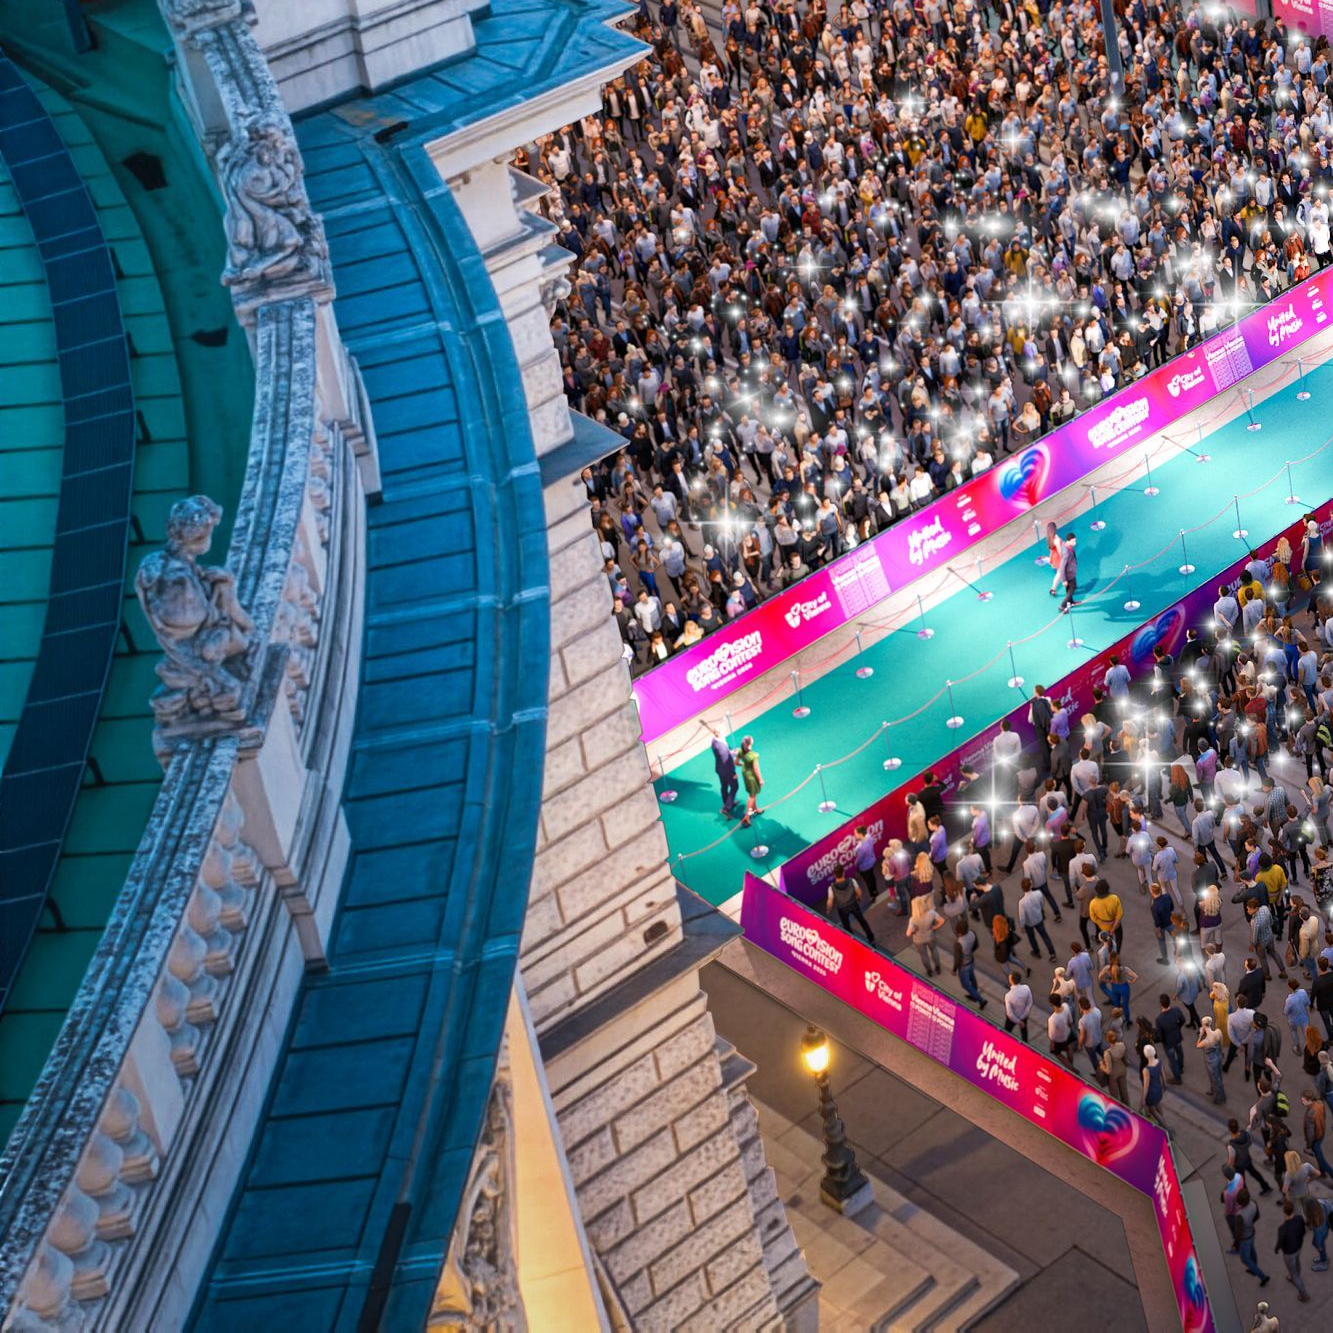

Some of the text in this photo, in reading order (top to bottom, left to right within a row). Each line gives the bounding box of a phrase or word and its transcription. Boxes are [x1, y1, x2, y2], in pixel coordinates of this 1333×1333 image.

[1291, 0, 1314, 15] Vienna
[780, 917, 844, 966] EUROVISION
[780, 930, 842, 975] SONG CONTEST
[877, 988, 902, 1012] Vienna
[878, 980, 903, 1002] City of
[911, 992, 955, 1026] Vienna Vienna
[976, 1054, 990, 1078] by
[988, 1063, 1020, 1092] Music
[982, 1040, 1018, 1076] United
